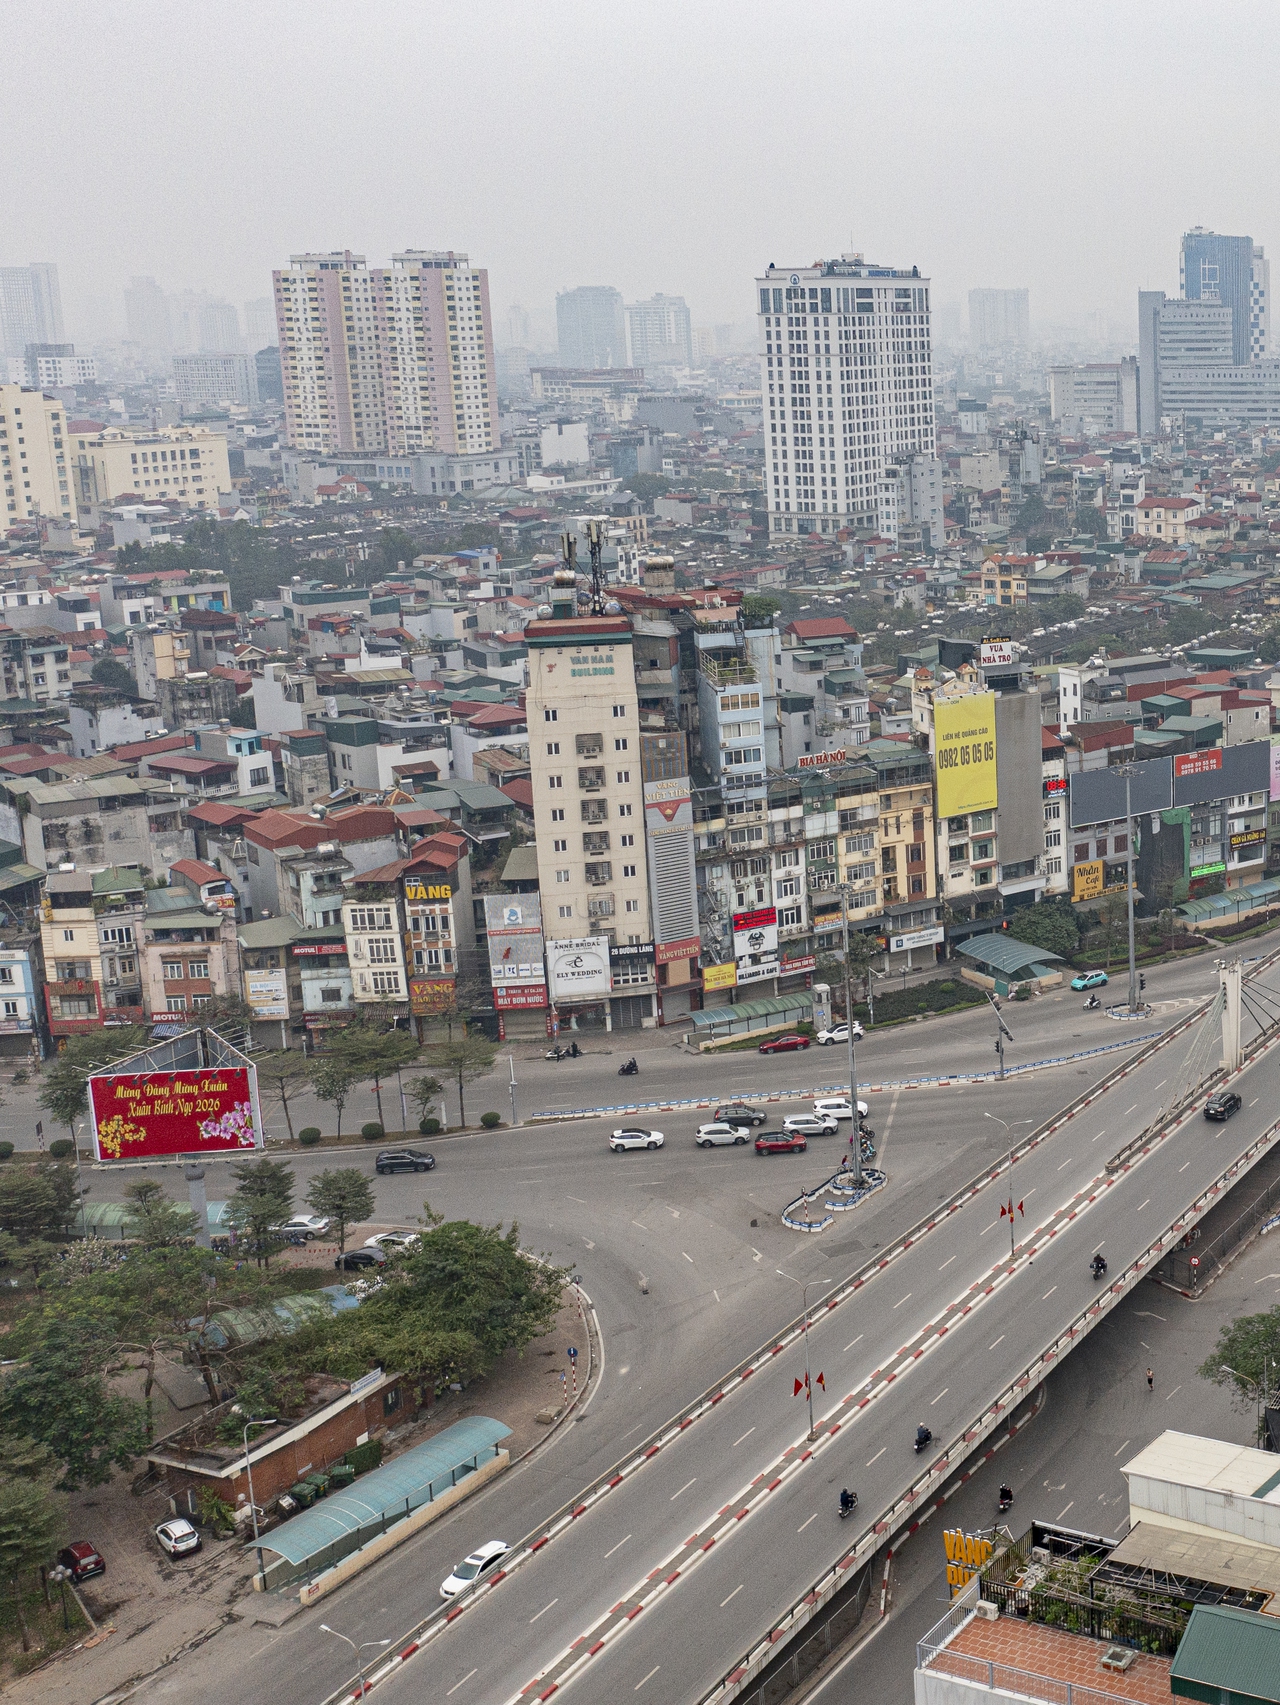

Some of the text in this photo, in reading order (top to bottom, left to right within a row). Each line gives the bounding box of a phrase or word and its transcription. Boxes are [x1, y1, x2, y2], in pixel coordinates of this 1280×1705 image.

[989, 645, 1004, 653] VUA
[571, 667, 615, 677] BUILDING
[942, 732, 953, 741] LIÊN
[798, 748, 846, 768] BIA HÀ NỘI
[938, 740, 994, 770] 0982 05 05 05
[406, 883, 452, 900] VÀNG
[611, 948, 618, 956] 26
[738, 970, 761, 980] BILLIARDS
[413, 982, 454, 995] VÀNG
[200, 1079, 228, 1093] Xuân
[127, 1100, 151, 1118] Xuân
[175, 1098, 194, 1116] Ngọ
[196, 1097, 221, 1112] 2026
[942, 1528, 993, 1567] VÀNG
